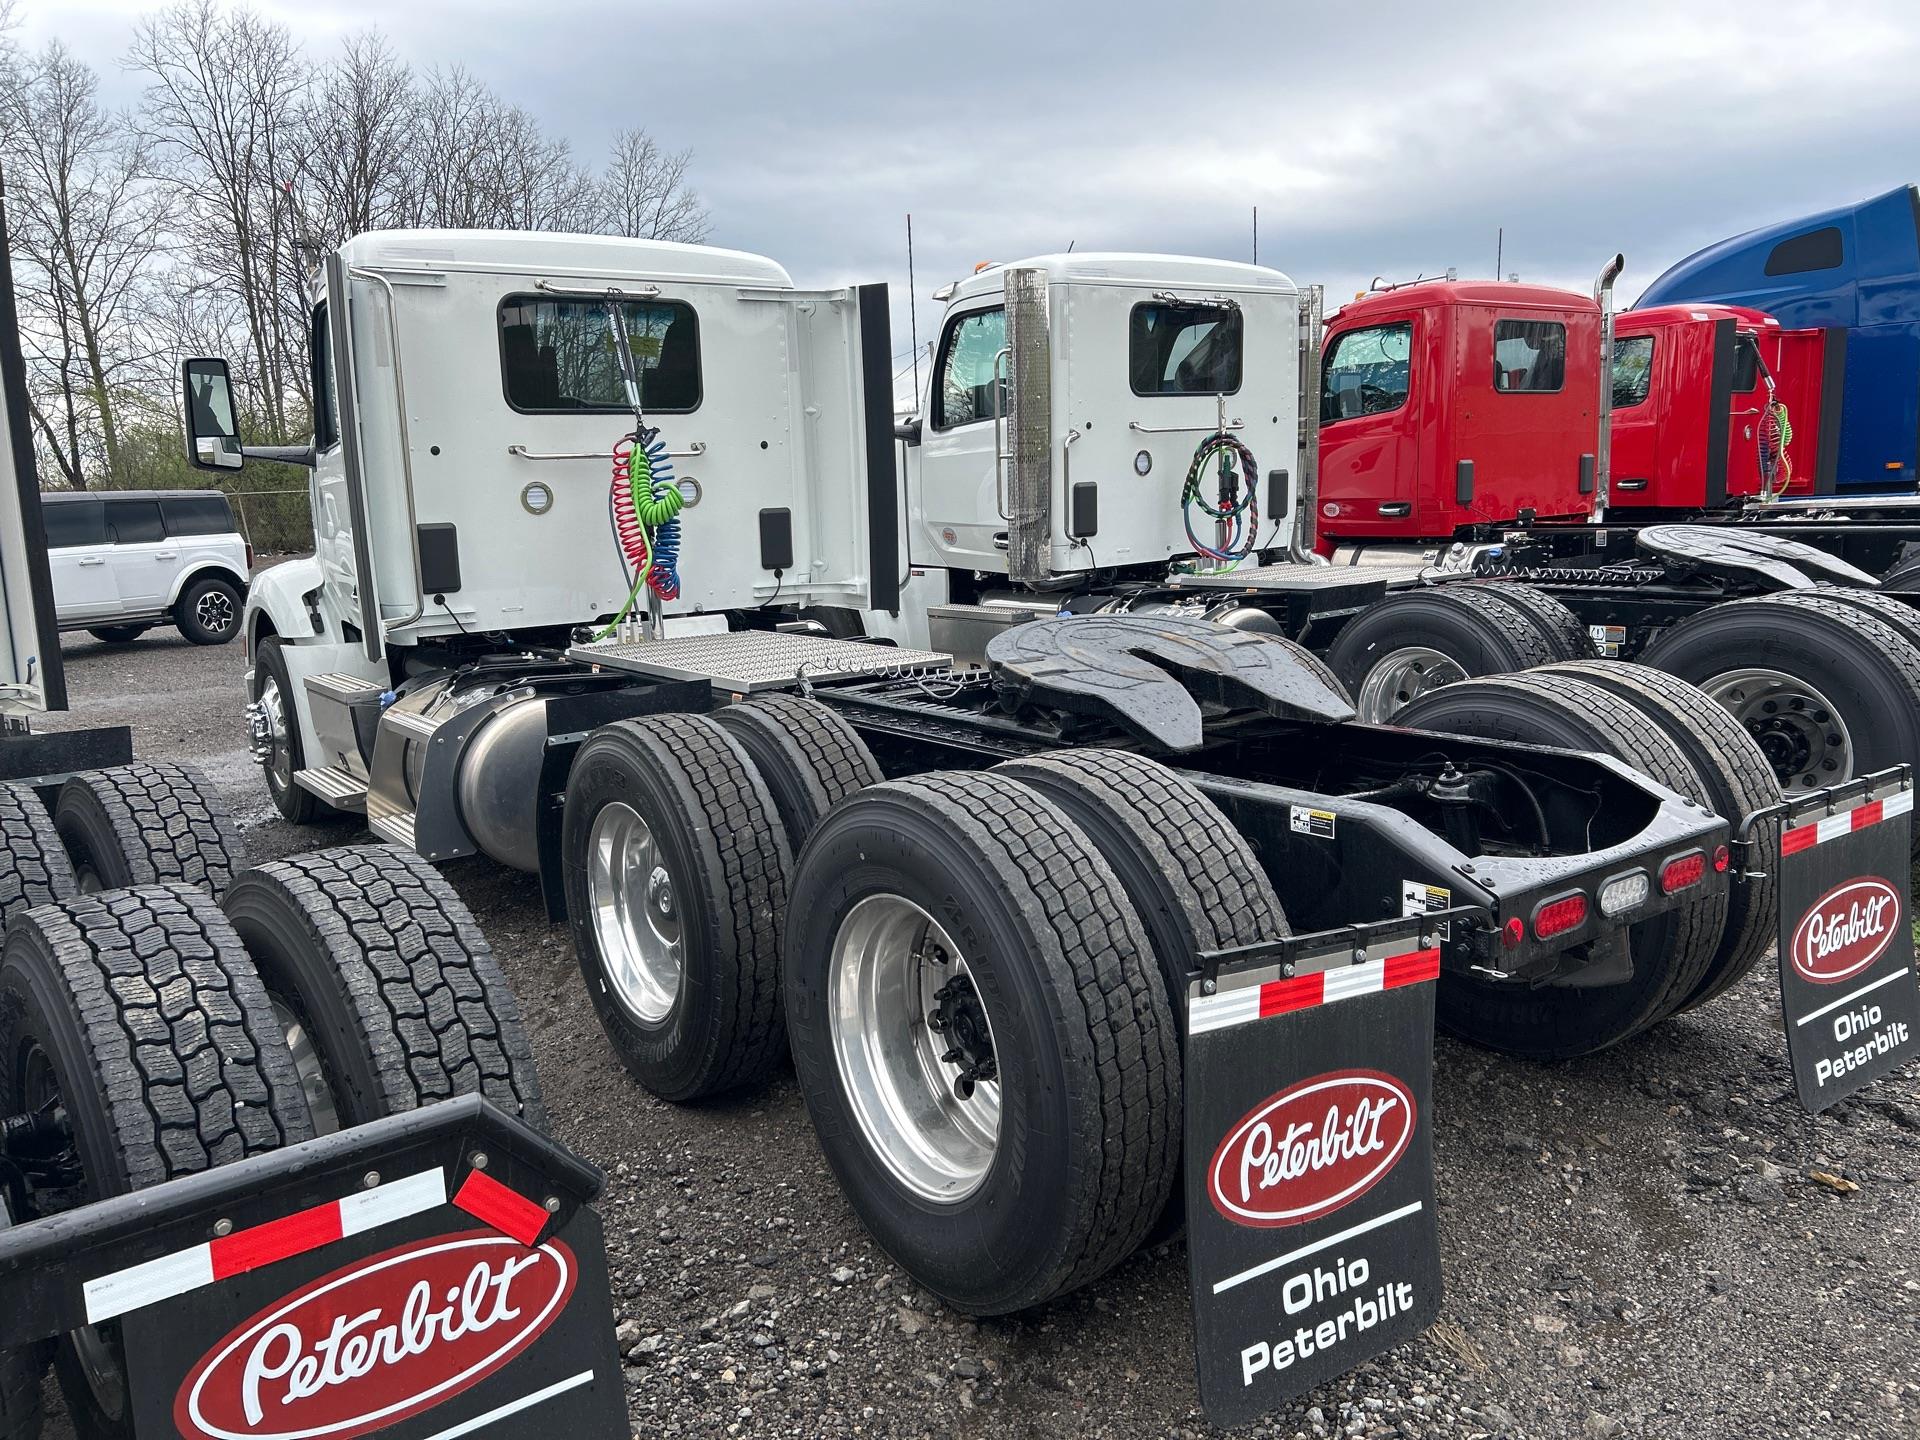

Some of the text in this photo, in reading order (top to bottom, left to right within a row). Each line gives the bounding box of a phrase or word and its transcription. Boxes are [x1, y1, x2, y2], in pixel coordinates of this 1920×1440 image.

[1807, 896, 1891, 968] Peterbilt
[1815, 1022, 1909, 1087] Peterbilt
[1834, 1005, 1882, 1043] Ohio
[1240, 1097, 1398, 1203] Peterbilt
[1283, 1258, 1370, 1316] Ohio
[242, 1252, 540, 1427] Peterbilt
[1241, 1281, 1414, 1387] Peterbilt
